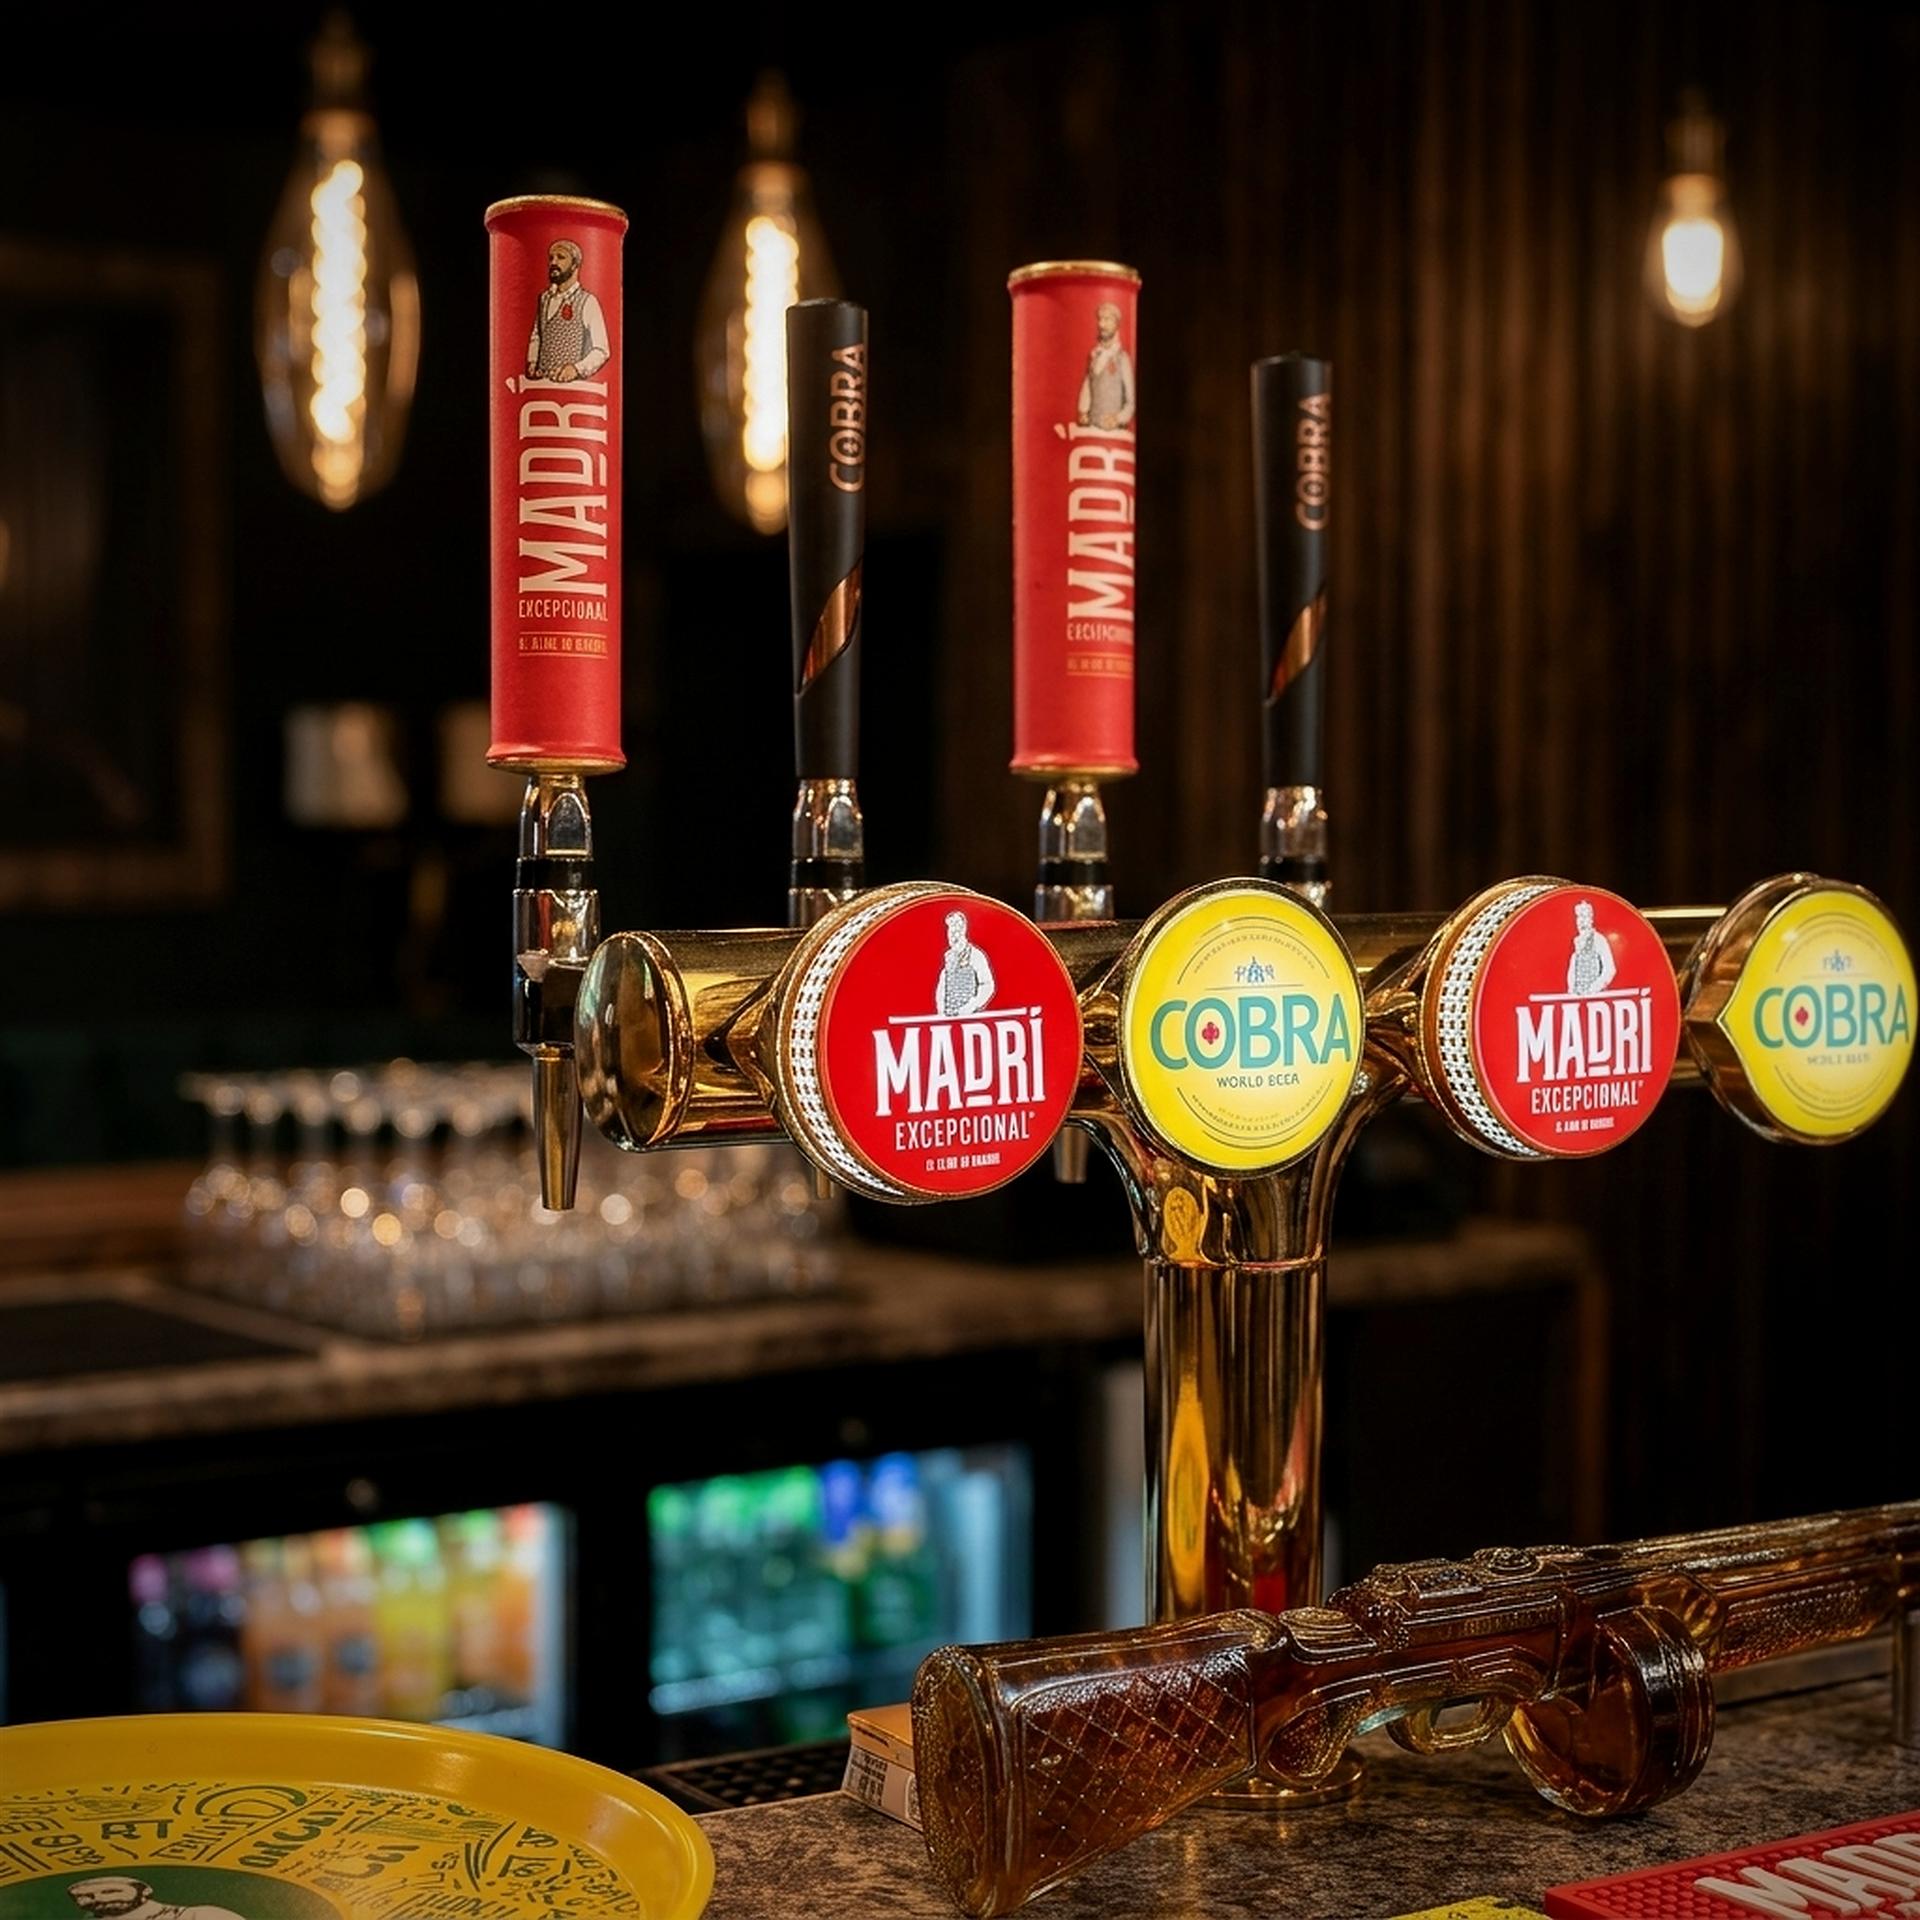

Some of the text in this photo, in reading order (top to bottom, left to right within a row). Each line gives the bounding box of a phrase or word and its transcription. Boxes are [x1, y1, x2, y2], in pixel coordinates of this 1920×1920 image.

[830, 343, 865, 493] COBRA
[1296, 393, 1332, 531] COBRA
[1150, 993, 1352, 1071] COBRA
[1515, 987, 1652, 1083] MADRÍ
[1754, 983, 1910, 1049] COBRA
[872, 1005, 1046, 1117] MADRÍ
[1531, 1080, 1638, 1115] EXCEPCIONAL
[895, 1110, 1030, 1152] EXCEPCIONAL
